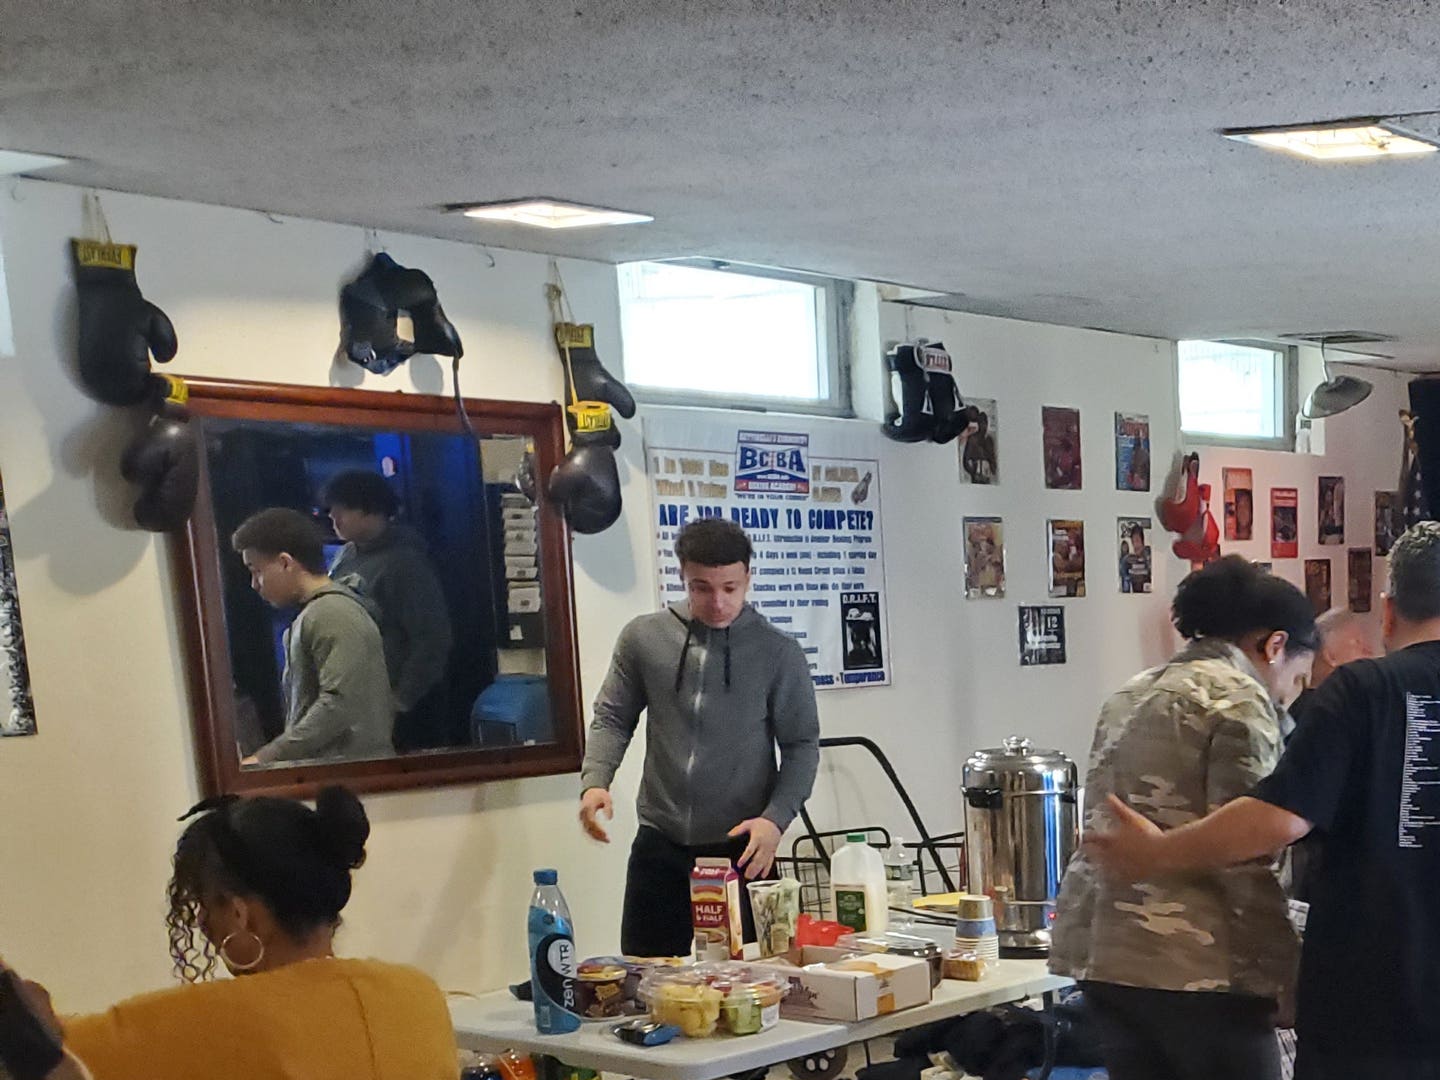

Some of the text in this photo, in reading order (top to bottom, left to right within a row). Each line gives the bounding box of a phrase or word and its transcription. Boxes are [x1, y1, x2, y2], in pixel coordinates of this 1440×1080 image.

[739, 446, 806, 473] BCBA
[659, 504, 689, 526] ARE
[731, 507, 779, 529] READY
[786, 509, 801, 529] TO
[809, 509, 875, 530] COMPETE?
[695, 905, 723, 914] HALF
[703, 914, 724, 922] HALF
